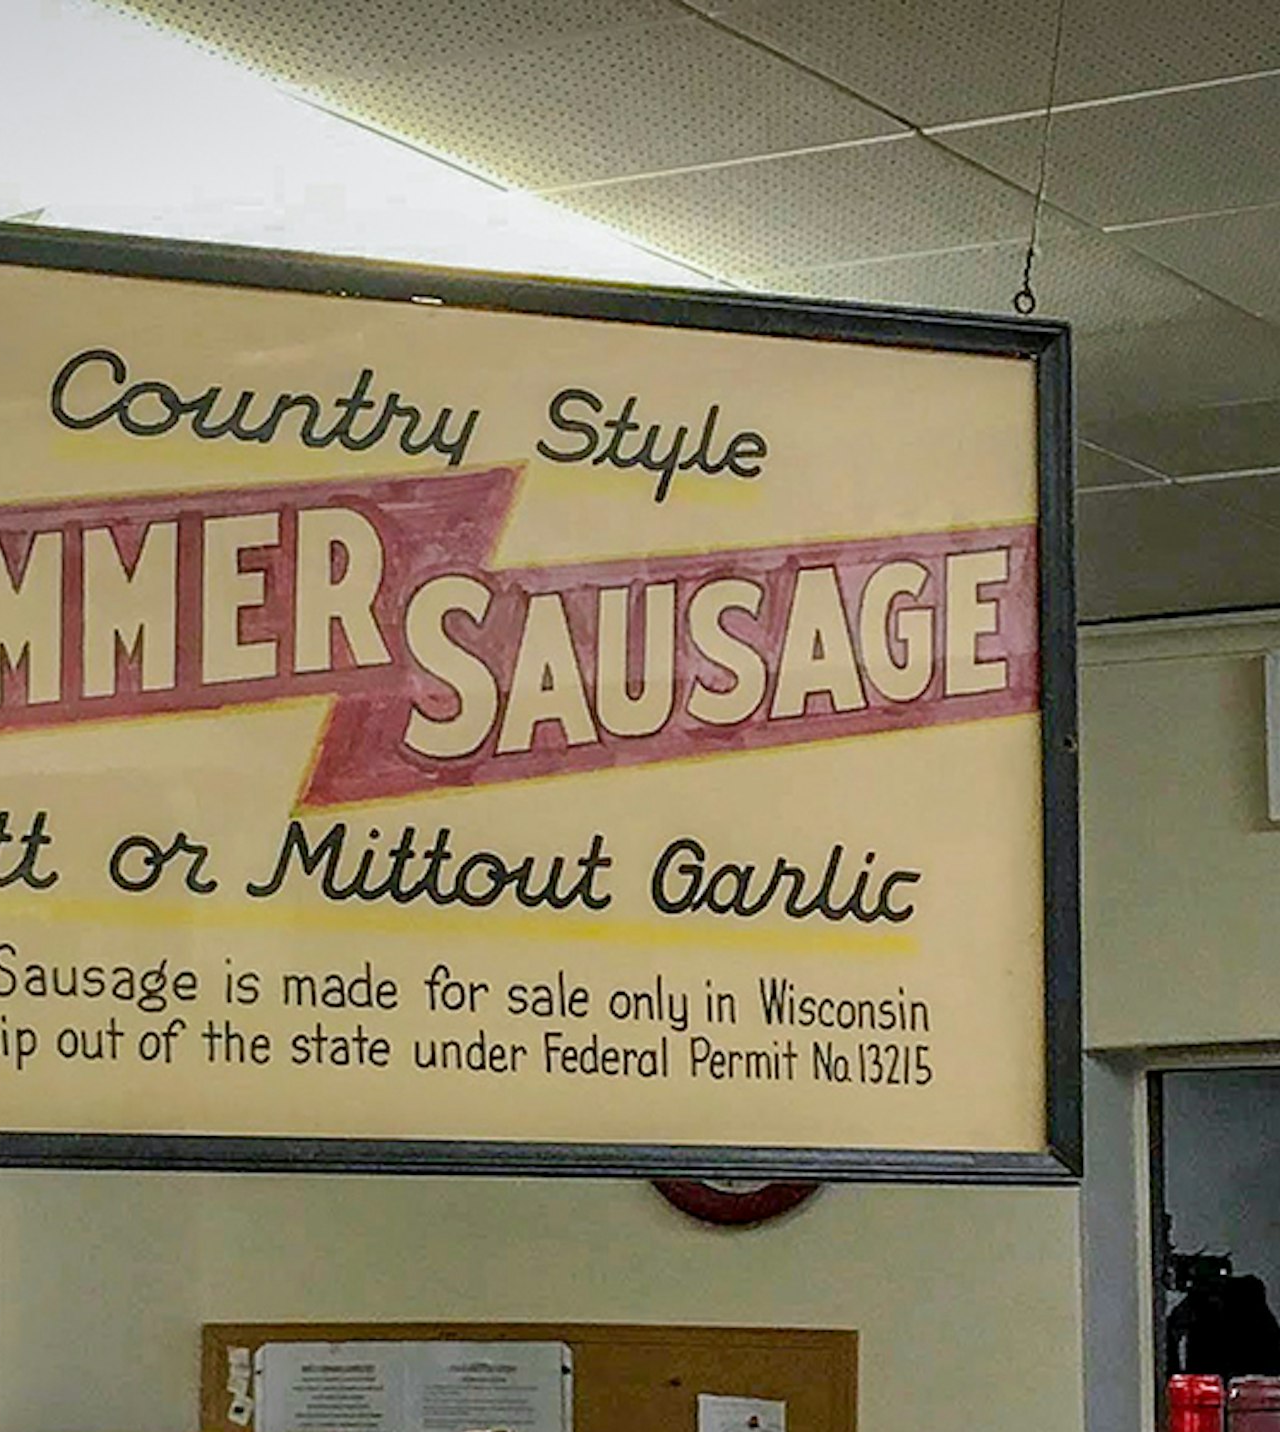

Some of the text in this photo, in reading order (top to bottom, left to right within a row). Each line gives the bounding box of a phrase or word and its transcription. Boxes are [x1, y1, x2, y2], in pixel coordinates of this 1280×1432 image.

[50, 348, 767, 502] Country Style
[402, 549, 1011, 759] SAUSAGE
[109, 831, 218, 894] or
[245, 819, 613, 910] Mittout
[651, 837, 921, 923] Garlic
[223, 957, 261, 1005] is
[282, 962, 399, 1011] made
[423, 964, 490, 1013] for
[506, 970, 590, 1019] sale
[608, 974, 690, 1031] only
[703, 980, 737, 1025] in
[759, 977, 931, 1032] Wisconsin
[57, 1017, 125, 1061] out
[137, 1019, 187, 1064] of
[201, 1020, 272, 1065] the
[290, 1023, 391, 1068] state
[412, 1030, 528, 1075] under
[542, 1031, 669, 1079] Federal
[689, 1036, 799, 1082] Permit
